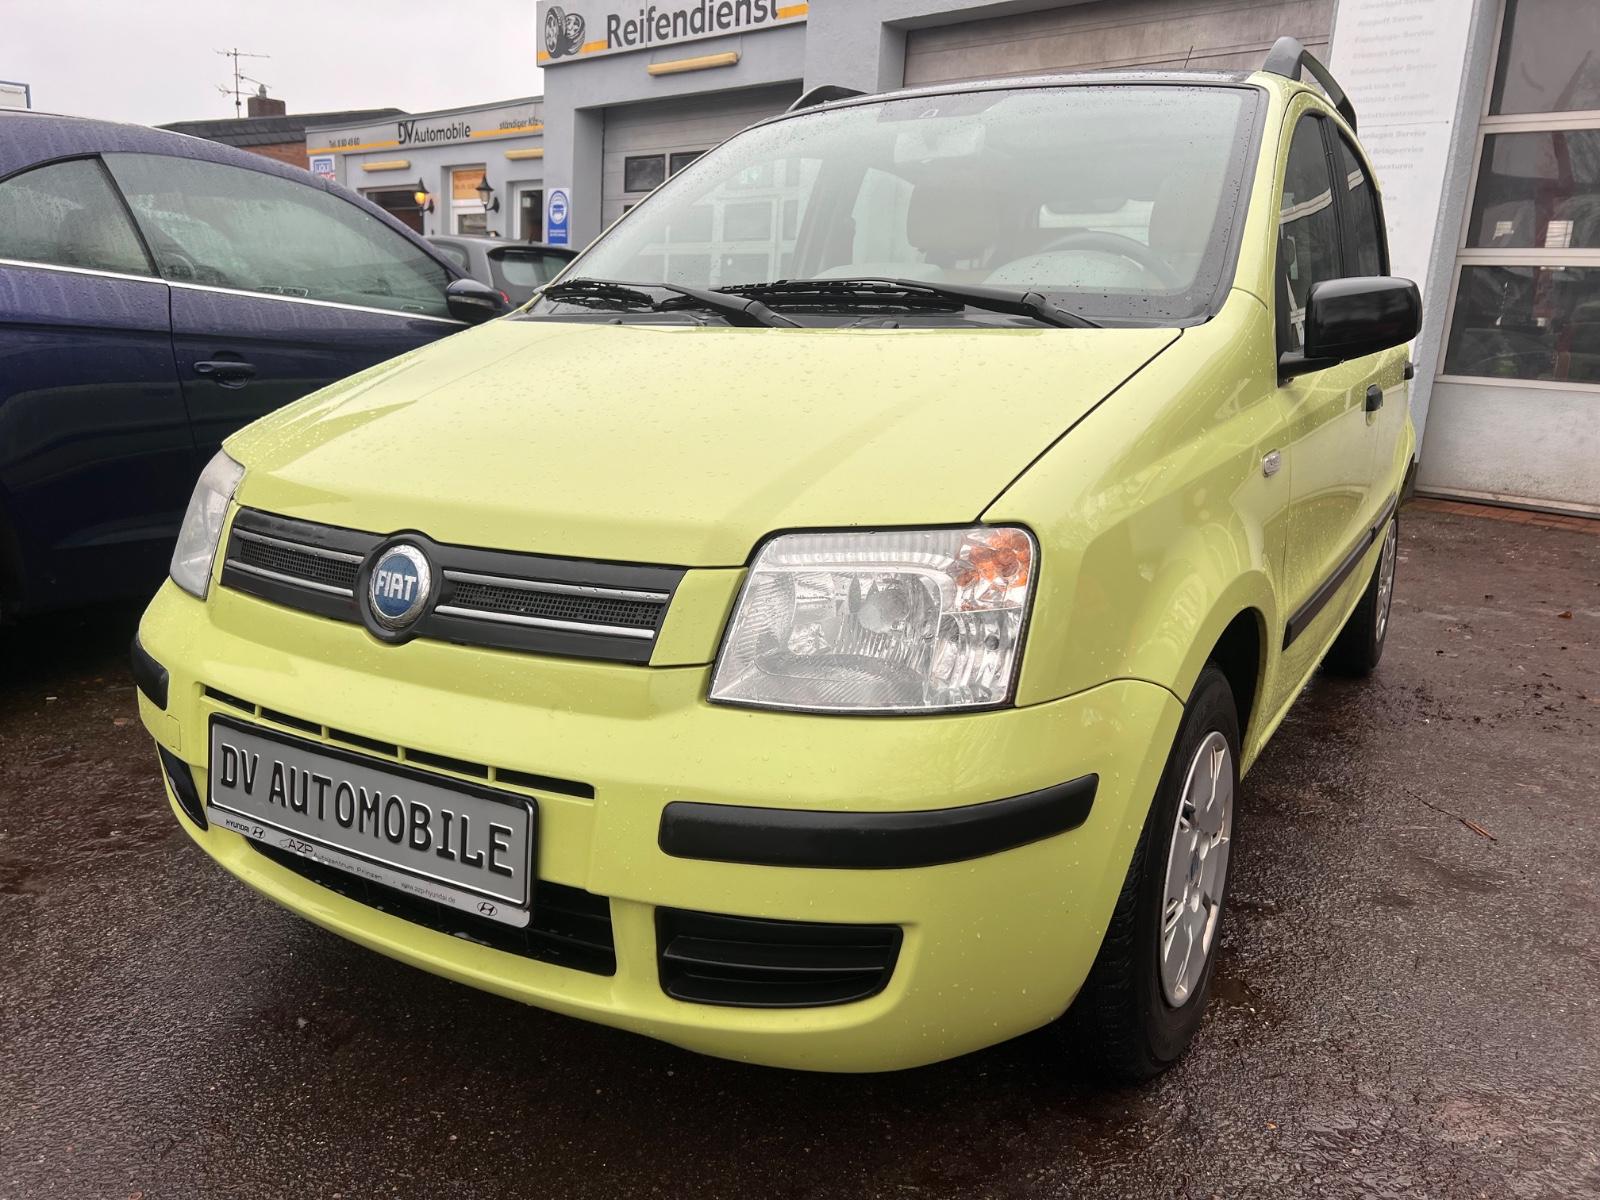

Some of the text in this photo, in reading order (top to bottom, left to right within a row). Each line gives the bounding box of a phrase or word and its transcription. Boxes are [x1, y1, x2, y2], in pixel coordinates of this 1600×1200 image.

[414, 122, 471, 143] Automobile
[375, 570, 416, 601] FIAT
[221, 743, 513, 877] DV AUTOMOBILE
[226, 819, 249, 832] HYUNDAI
[288, 839, 313, 854] AZP
